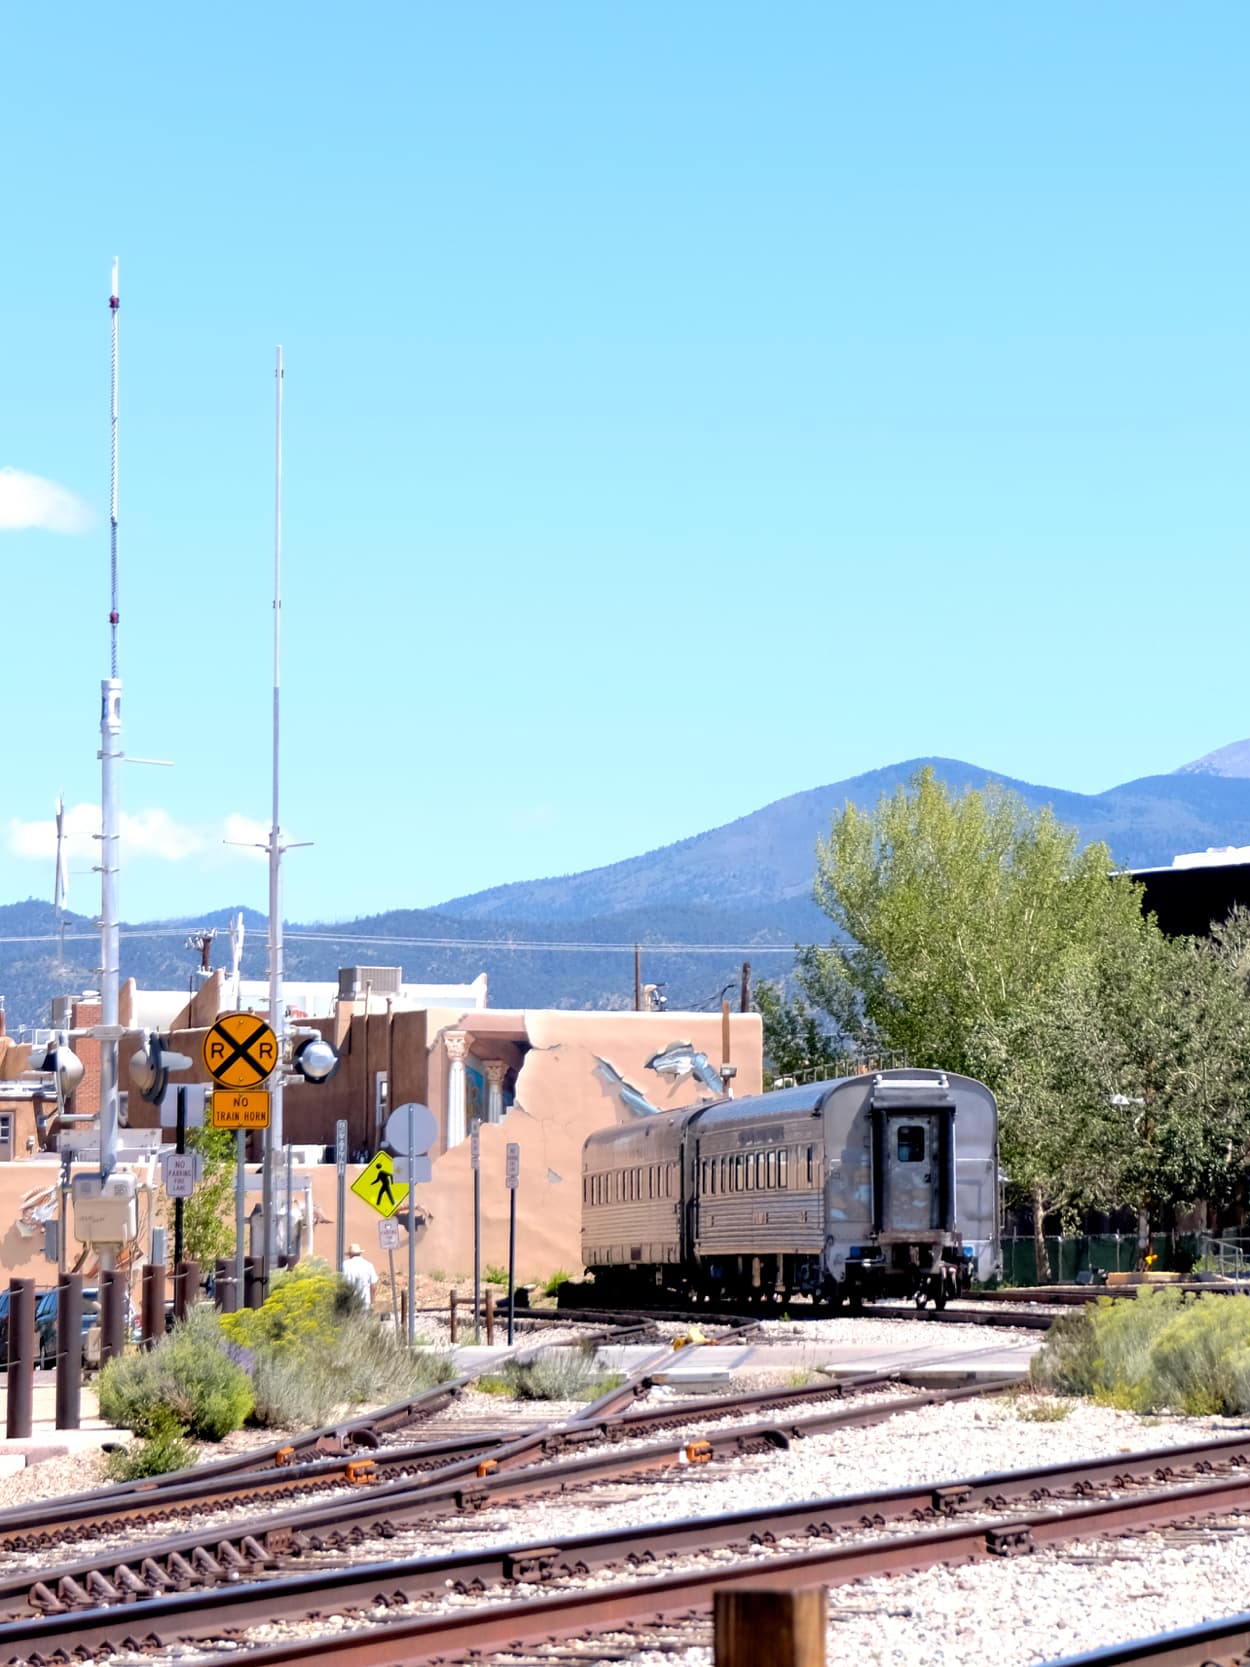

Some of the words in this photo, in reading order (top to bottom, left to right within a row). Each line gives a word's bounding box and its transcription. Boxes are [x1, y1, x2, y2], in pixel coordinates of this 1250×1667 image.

[211, 1042, 224, 1059] R
[259, 1042, 273, 1059] R
[233, 1097, 248, 1107] NO
[216, 1111, 240, 1121] TRAIN
[244, 1111, 266, 1121] HORN
[175, 1160, 186, 1169] NO
